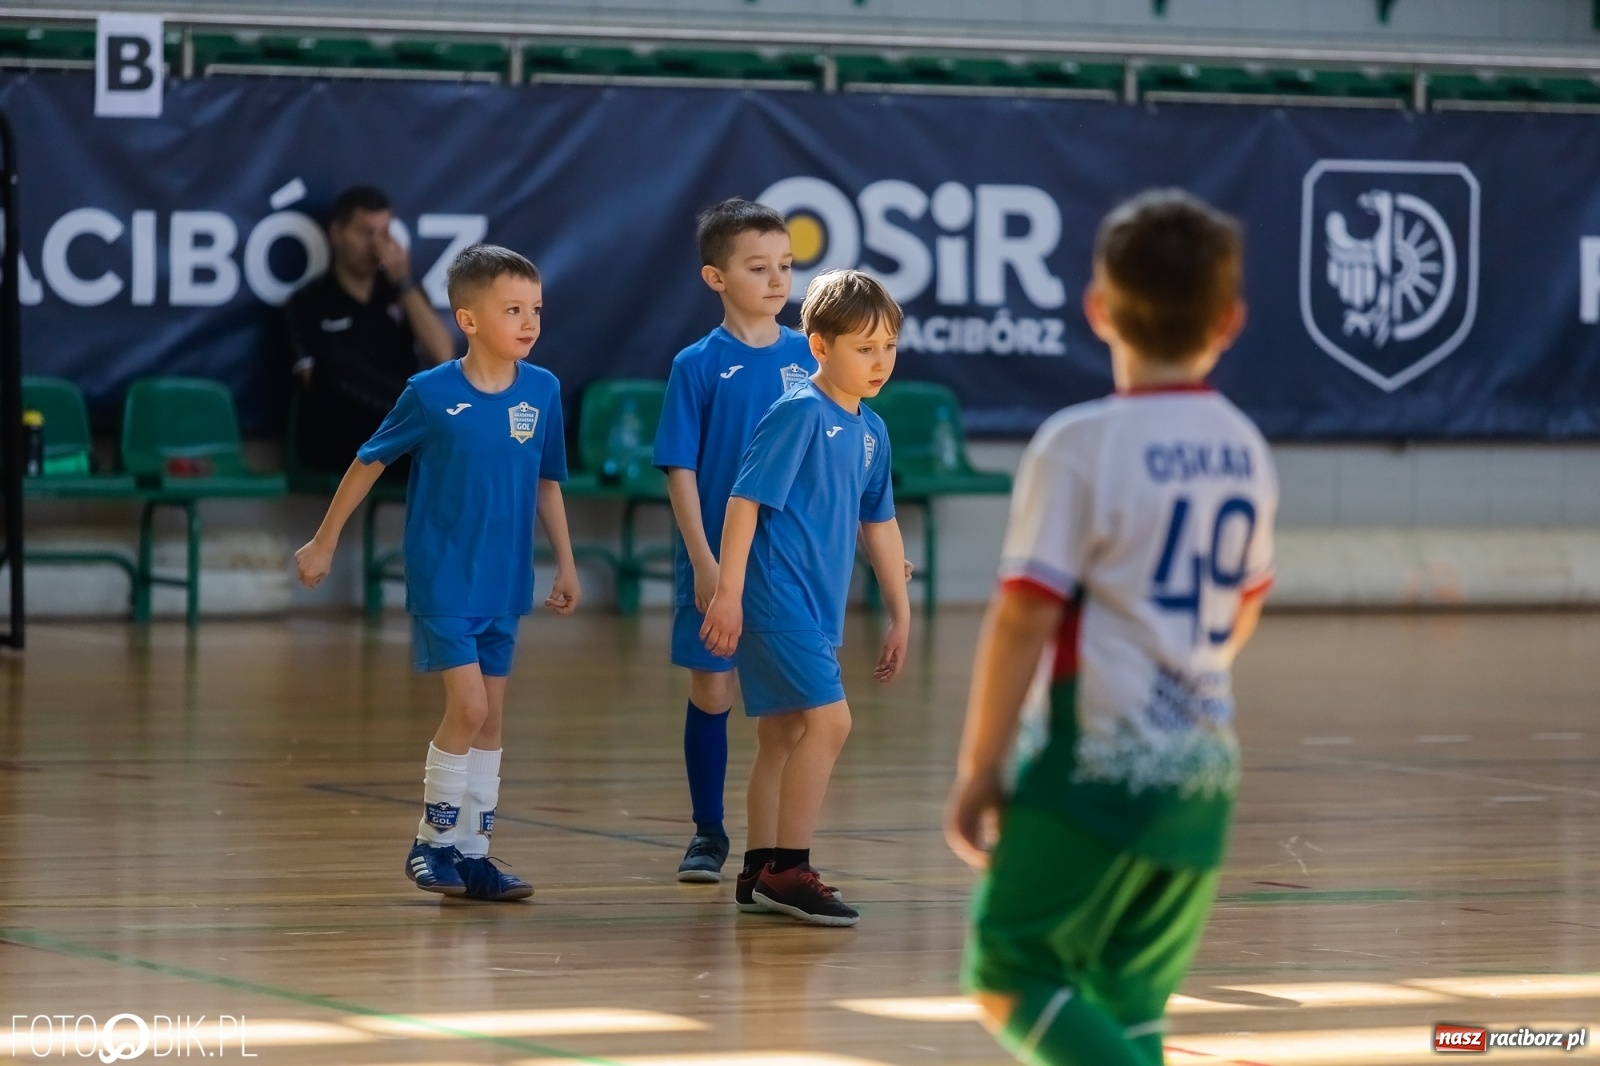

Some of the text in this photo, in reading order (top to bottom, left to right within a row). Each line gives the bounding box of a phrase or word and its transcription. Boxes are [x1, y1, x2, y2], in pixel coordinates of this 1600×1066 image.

[106, 35, 155, 92] B
[0, 177, 488, 309] CIBÓZ
[897, 308, 1067, 356] ACIBÓRZ
[516, 422, 531, 431] GOL
[1150, 496, 1257, 647] 49
[432, 816, 452, 825] GOL
